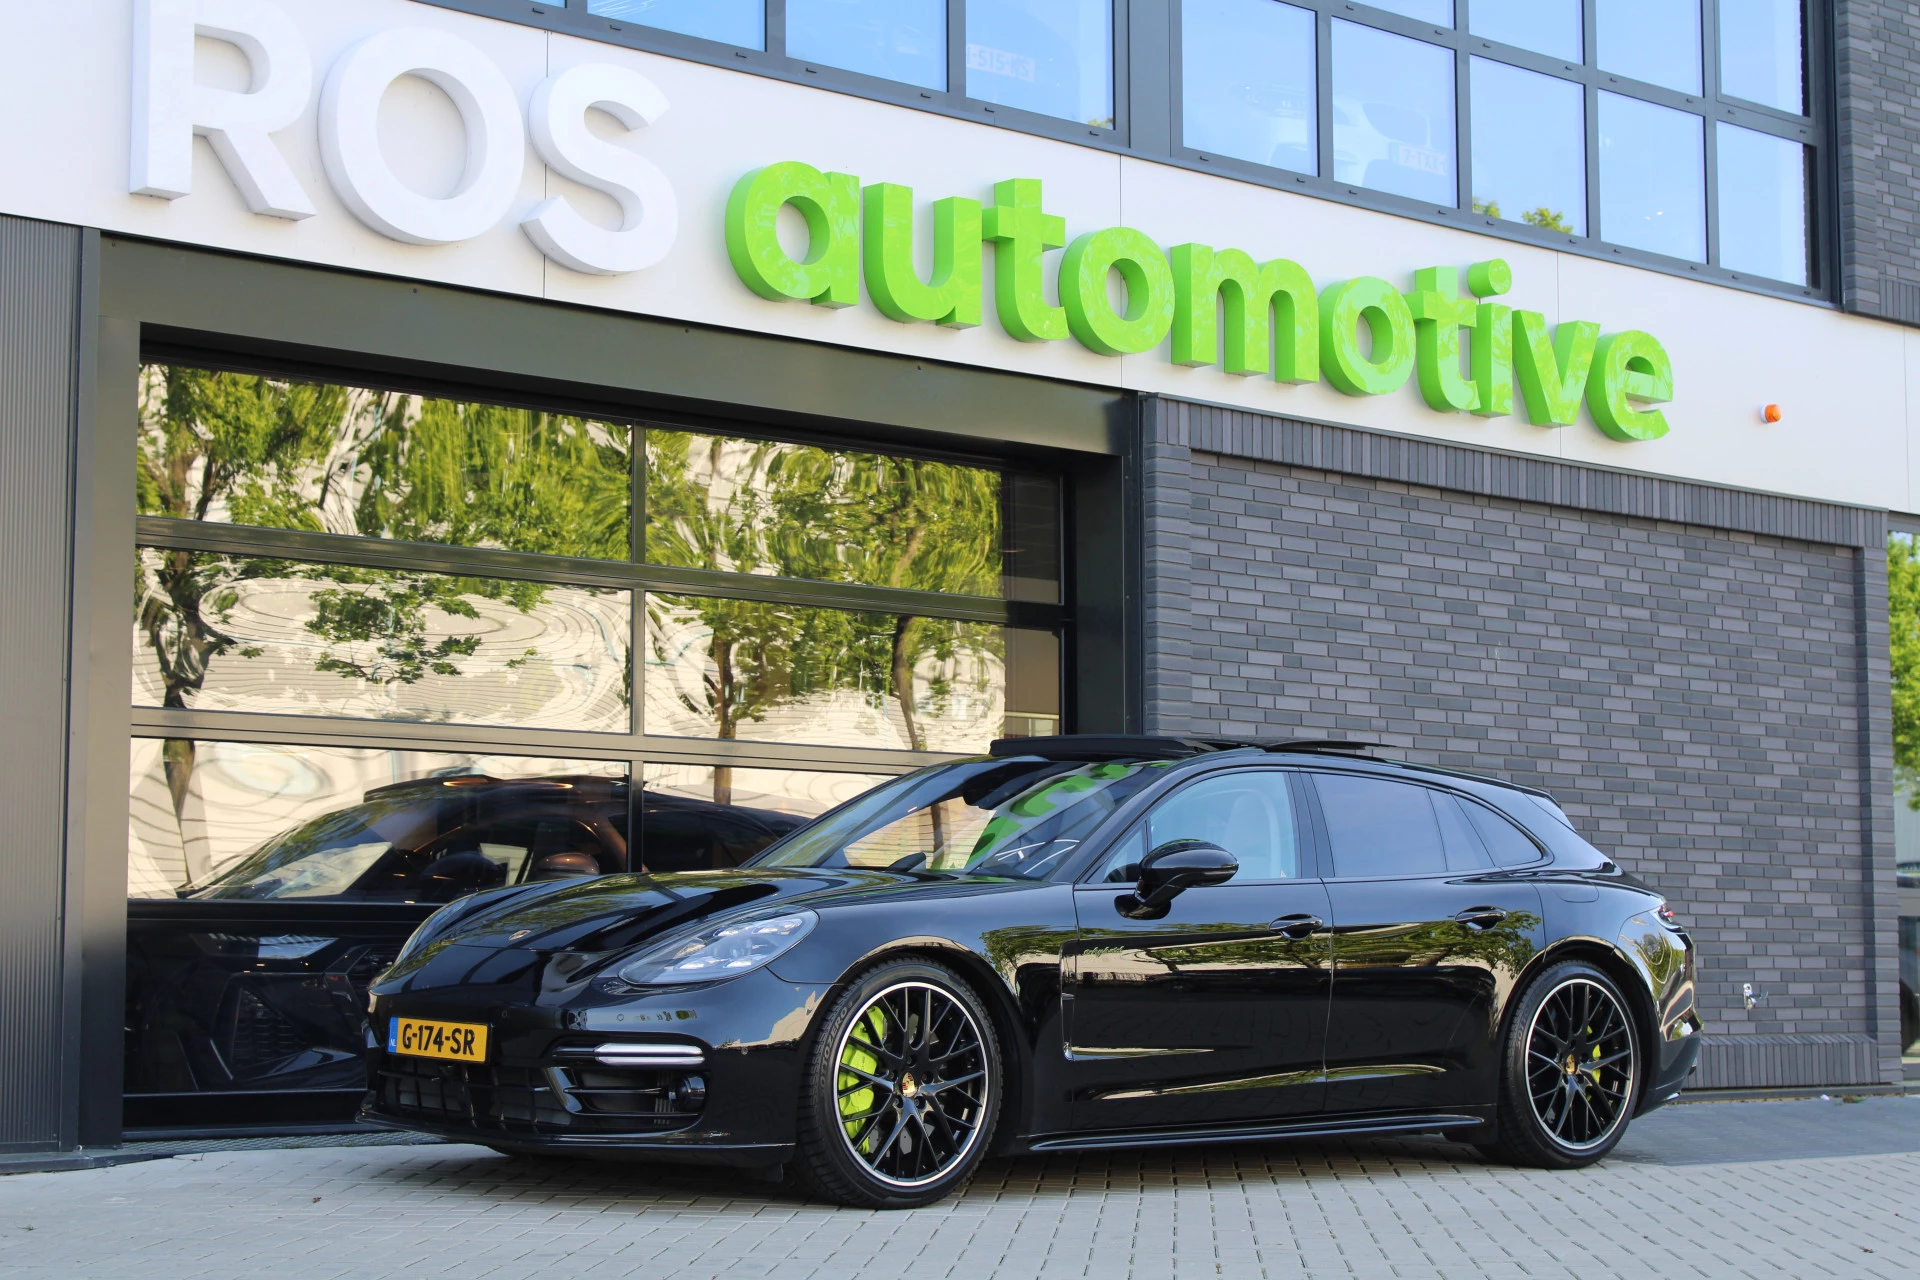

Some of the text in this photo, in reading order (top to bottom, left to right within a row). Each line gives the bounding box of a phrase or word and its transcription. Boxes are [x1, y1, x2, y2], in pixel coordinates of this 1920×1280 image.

[129, 0, 1674, 443] ROS automotive
[402, 1023, 475, 1056] G-174-SR
